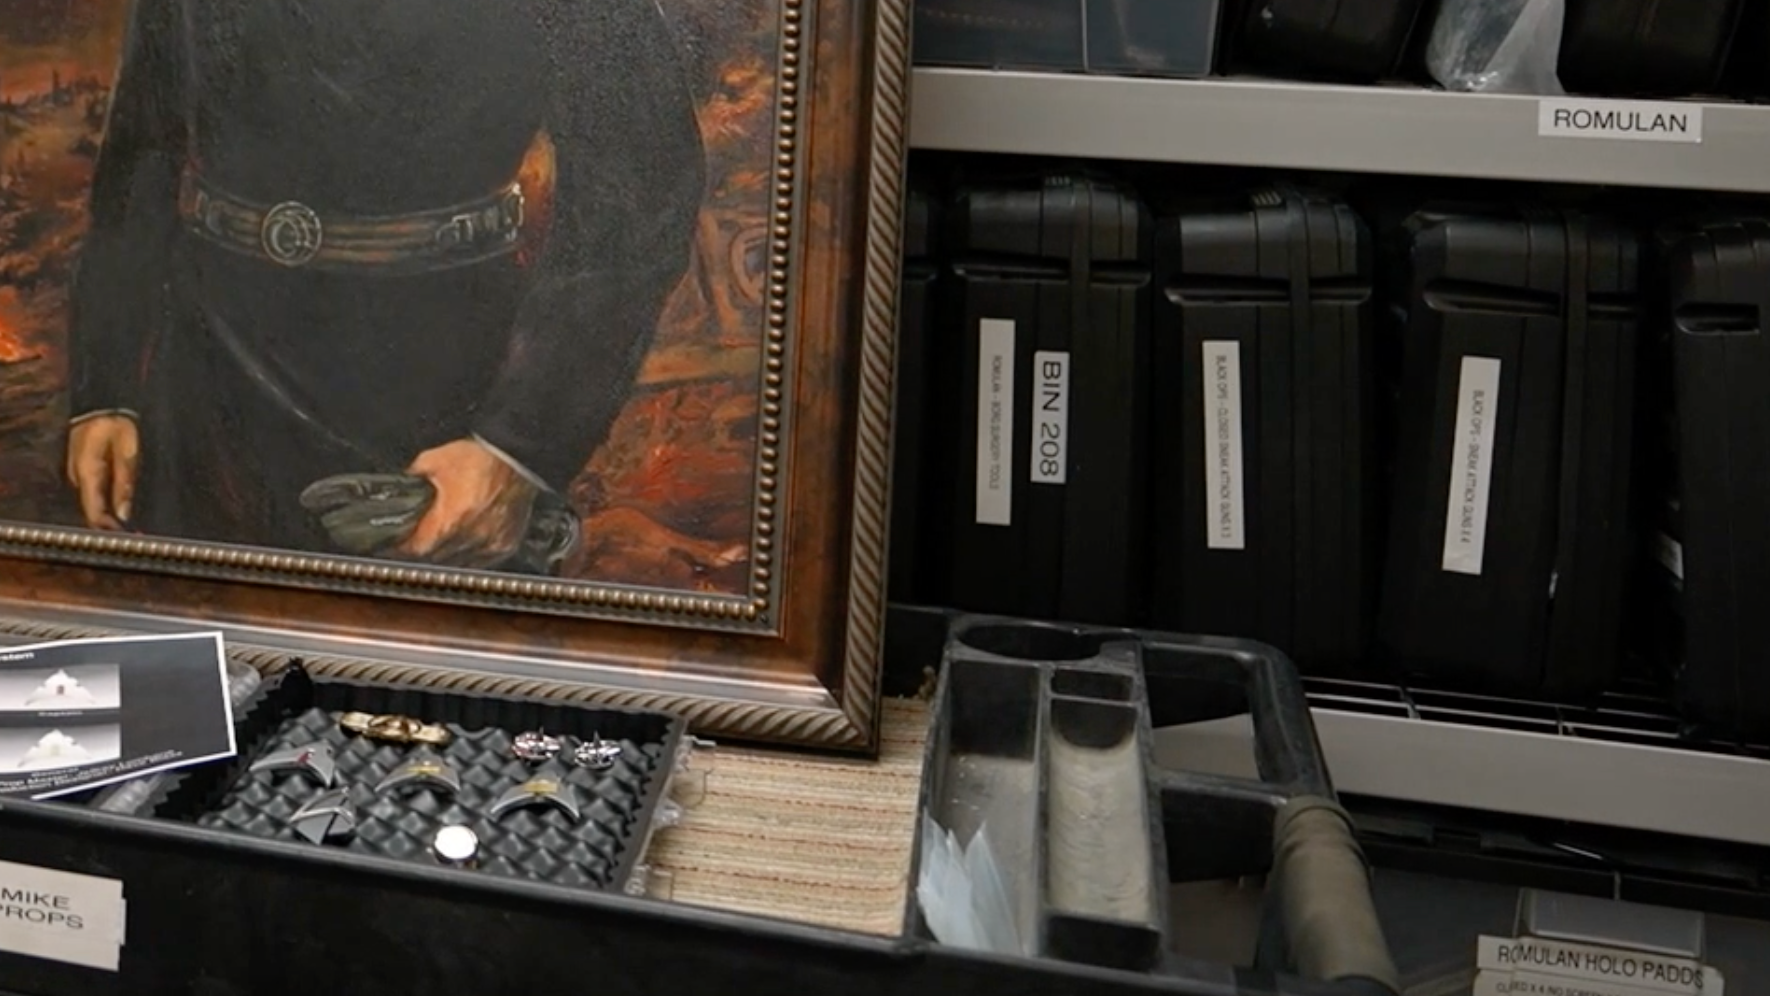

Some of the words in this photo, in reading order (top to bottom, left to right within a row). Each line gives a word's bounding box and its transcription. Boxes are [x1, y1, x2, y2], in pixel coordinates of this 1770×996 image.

[1554, 108, 1687, 133] ROMULAN
[1216, 354, 1229, 381] BLACK
[1042, 360, 1062, 413] BIN
[1217, 382, 1229, 400] OPS
[1472, 389, 1485, 416] BLACK
[1470, 417, 1484, 436] OPS
[1039, 421, 1061, 477] 208
[1, 887, 70, 910] MIKE
[1497, 944, 1580, 969] ROMULAN
[1585, 955, 1638, 978] HOLO
[1642, 963, 1704, 990] PADDS
